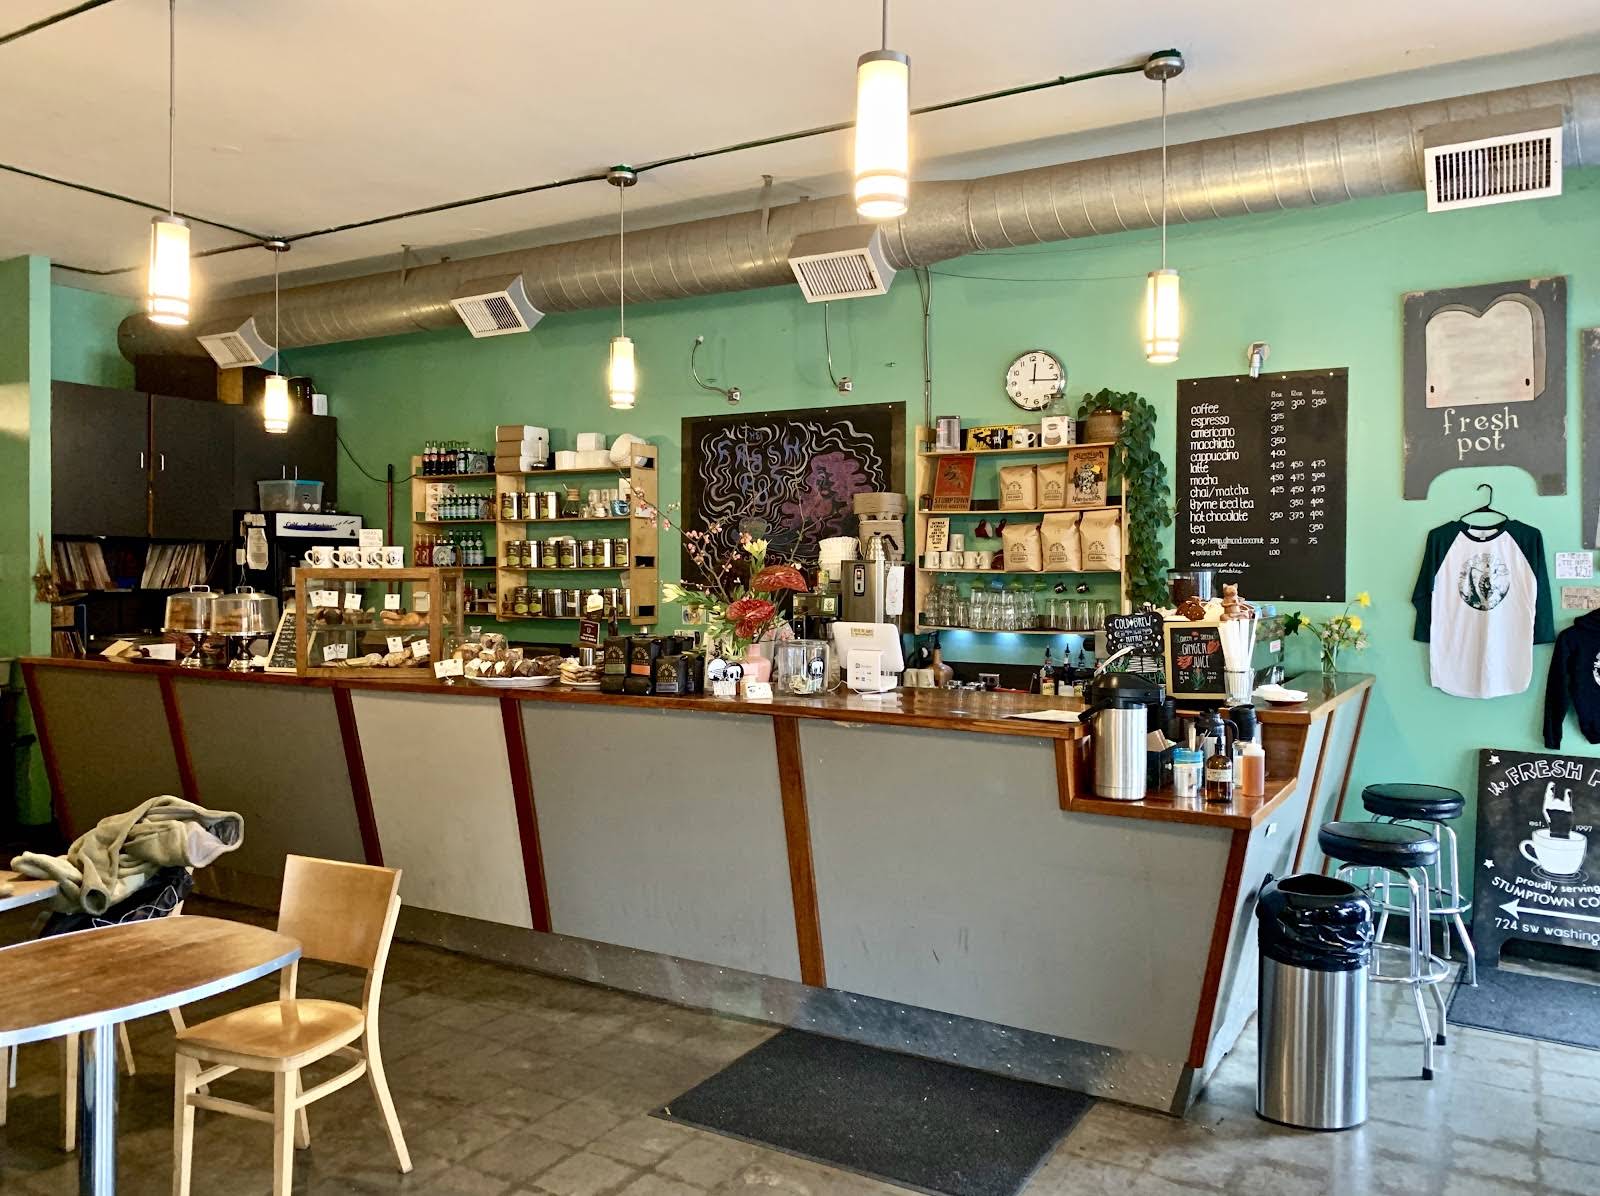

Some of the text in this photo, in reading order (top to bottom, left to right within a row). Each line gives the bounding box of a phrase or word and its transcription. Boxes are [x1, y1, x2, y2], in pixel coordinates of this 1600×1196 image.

[1190, 398, 1327, 415] coffee 250 300 350
[1190, 413, 1285, 429] espresso 325
[1443, 406, 1519, 435] fresh
[1190, 425, 1285, 439] americano 325
[1190, 437, 1287, 451] macchiato 350
[1457, 430, 1505, 461] pot
[1190, 449, 1287, 464] cappuccino 400
[1190, 459, 1327, 474] latte 425 450 475
[1190, 472, 1326, 486] mocha 450 475 500
[1189, 483, 1326, 499] chai/matcha 425 450 475
[1189, 497, 1325, 512] thyme iced tea 350 400
[1189, 509, 1324, 523] hot chocolate 350 375 400
[1189, 523, 1324, 535] tea 350
[1114, 615, 1152, 629] COLD BREW
[1181, 642, 1207, 655] GINGER
[1192, 655, 1210, 669] JUICE
[1488, 781, 1509, 796] the
[1505, 760, 1583, 786] FRESH
[1529, 820, 1545, 828] est.
[1492, 876, 1600, 909] STUMPTOWN CO
[1515, 876, 1600, 895] proudly serving
[1495, 917, 1518, 931] 724
[1522, 924, 1540, 934] sw
